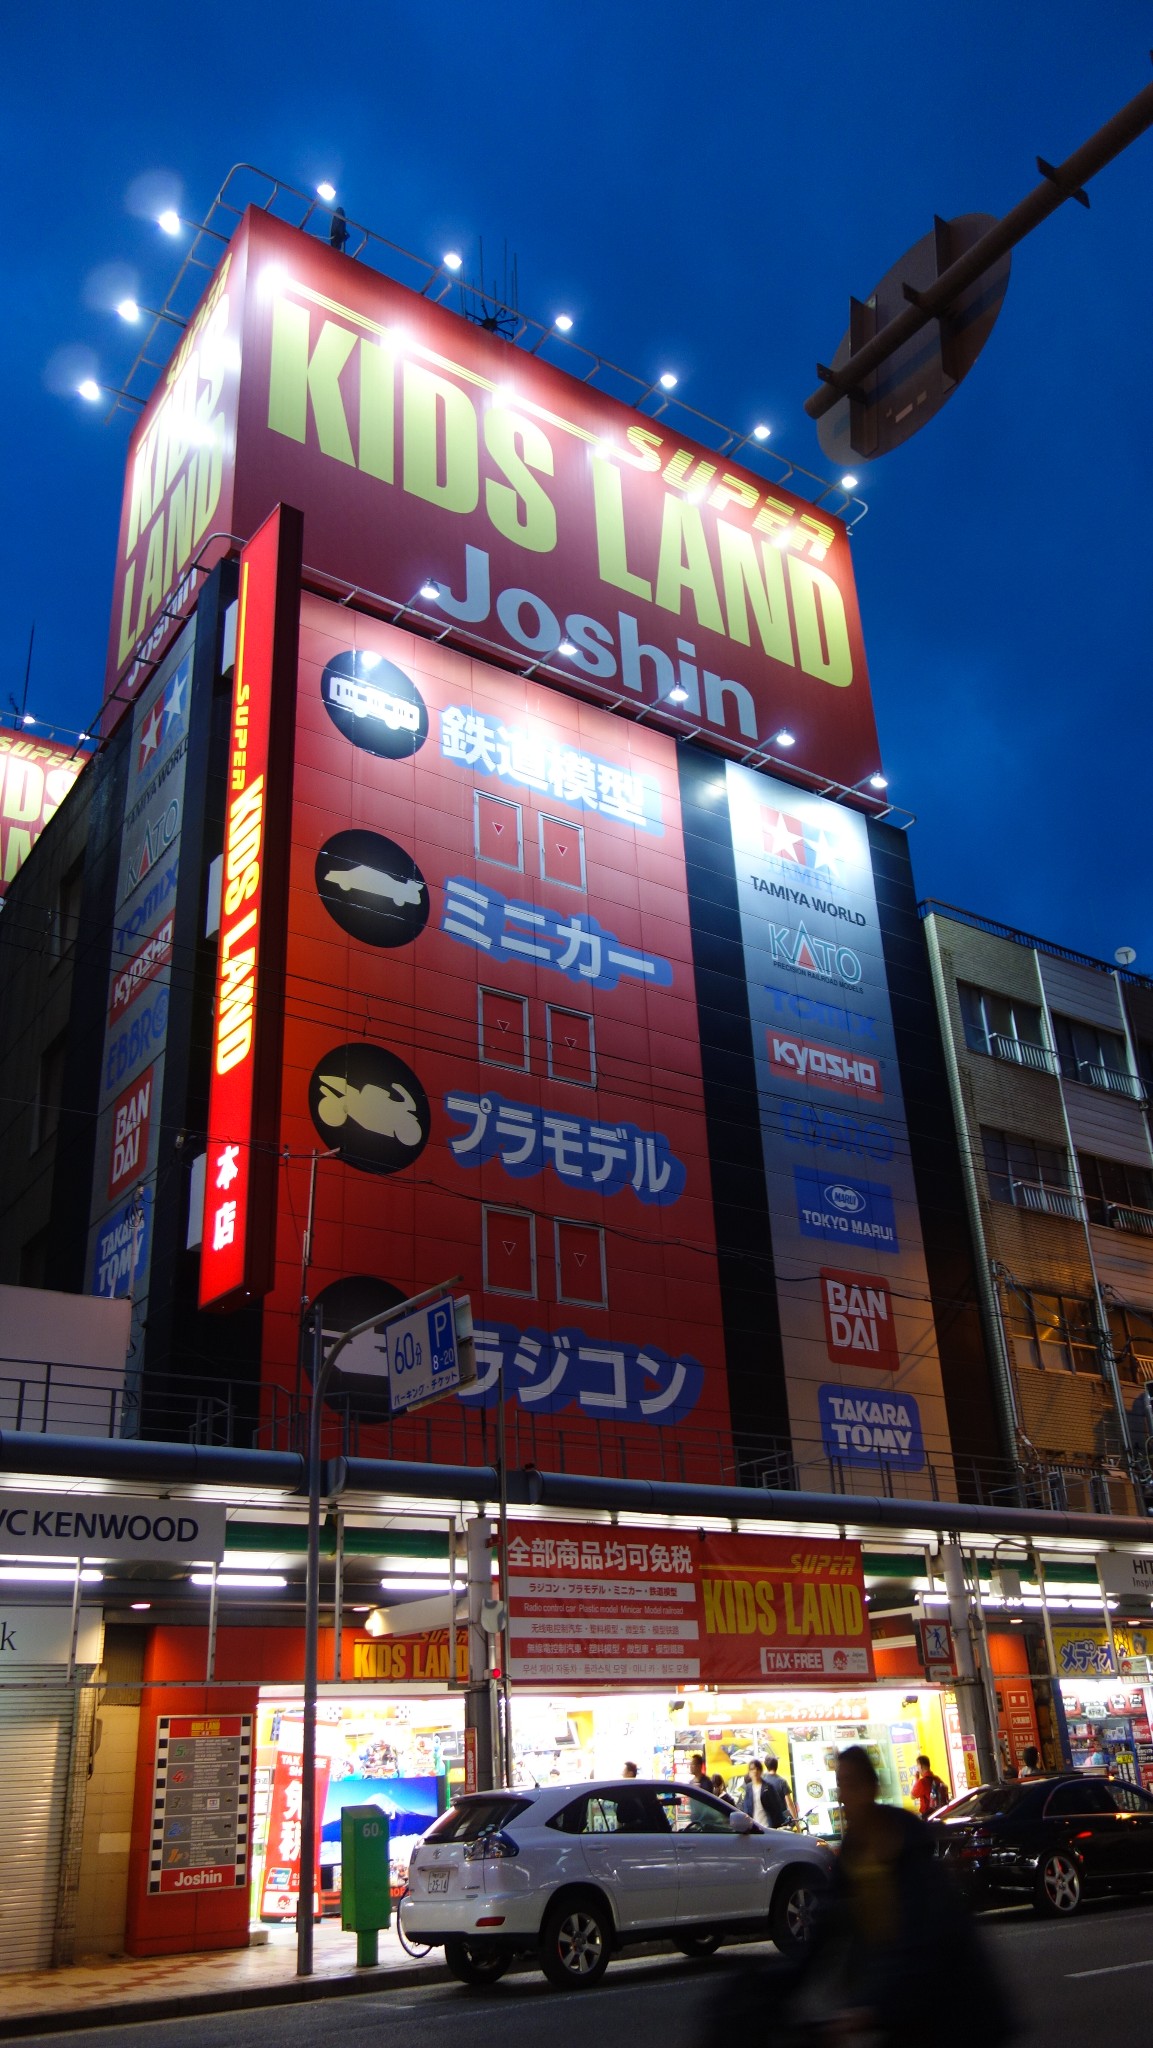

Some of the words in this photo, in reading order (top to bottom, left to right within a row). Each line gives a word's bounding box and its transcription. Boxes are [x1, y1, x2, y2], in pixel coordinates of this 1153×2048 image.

[267, 298, 558, 553] KIDS
[593, 456, 853, 688] LAND
[614, 425, 836, 562] SUPER
[117, 411, 226, 671] LAND
[438, 544, 759, 740] Joshin
[231, 683, 250, 790] SUPER
[442, 706, 648, 827] 鉄道模型
[124, 798, 181, 899] KATO
[224, 774, 264, 915] KIDS
[750, 875, 811, 909] TAMIYA
[811, 897, 867, 927] WORLD
[444, 879, 656, 978] ミニカー
[768, 919, 862, 985] KATO
[217, 908, 258, 1076] LAND
[773, 960, 807, 977] PRECISION
[838, 980, 864, 995] MODELS
[772, 1038, 877, 1087] KYOSHO
[115, 1082, 151, 1141] BAN
[112, 1125, 141, 1185] DAI
[447, 1096, 671, 1193] プラモデル
[212, 1145, 241, 1252] 本店
[834, 1191, 858, 1206] MARUI
[802, 1209, 849, 1232] TOKYO
[851, 1219, 894, 1241] MARUI
[826, 1279, 888, 1320] BAN
[394, 1332, 422, 1375] 60分
[434, 1310, 447, 1349] P
[830, 1314, 880, 1352] DAI
[432, 1347, 455, 1371] 8-20
[457, 1329, 687, 1415] ラジコン
[828, 1397, 911, 1428] TAKARA
[831, 1423, 913, 1456] TOMY
[0, 1509, 199, 1542] CKENWOOD
[507, 1536, 694, 1574] 全部商品均可免税
[789, 1553, 857, 1576] SUPER
[524, 1602, 542, 1612] Radio
[542, 1604, 565, 1612] control
[565, 1605, 577, 1613] car
[578, 1604, 600, 1613] Plastic
[600, 1605, 619, 1614] model
[702, 1578, 778, 1636] KIDS
[783, 1581, 864, 1636] LAND
[354, 1644, 407, 1678] KIDS
[420, 1630, 469, 1643] SUPR
[174, 1870, 222, 1887] Joshin
